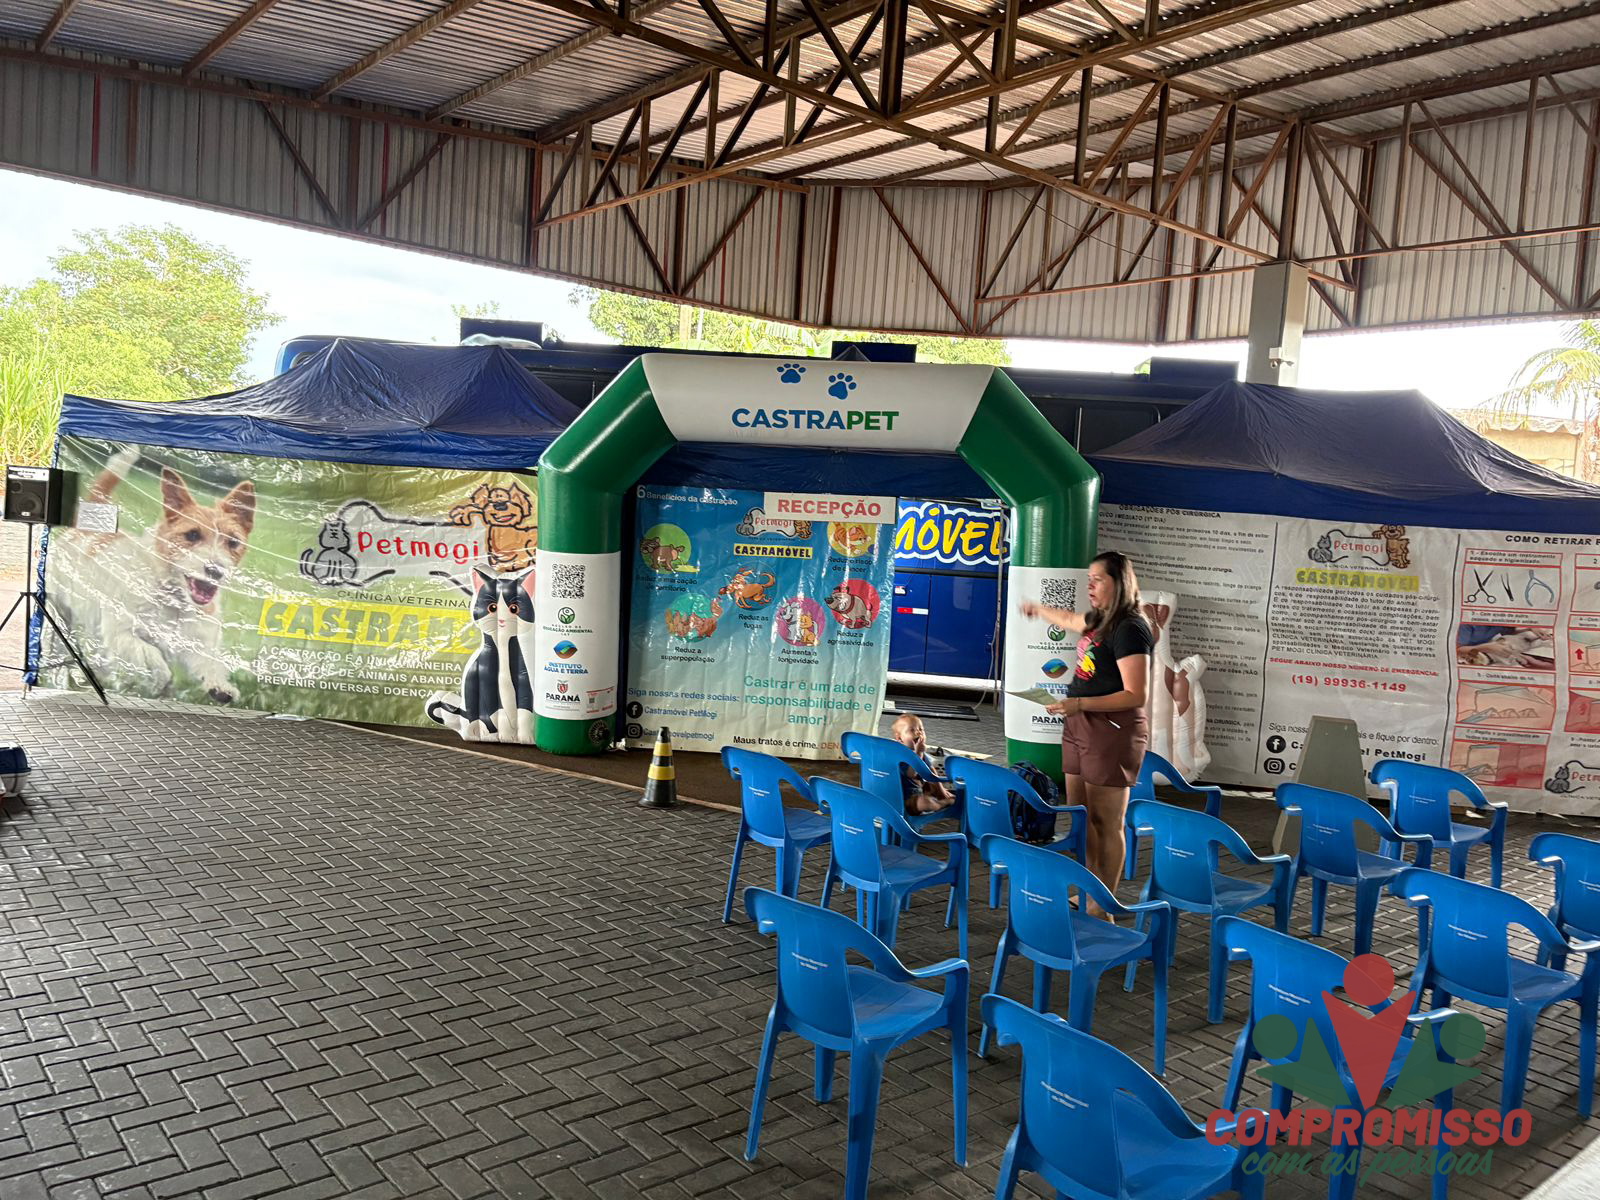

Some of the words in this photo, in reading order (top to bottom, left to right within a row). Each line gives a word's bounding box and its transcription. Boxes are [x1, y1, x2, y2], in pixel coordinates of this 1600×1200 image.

[732, 408, 899, 431] CASTRAPET
[778, 499, 882, 519] RECEPÇÃO
[358, 531, 479, 564] Petmogi
[1333, 540, 1384, 554] Petmogi
[1505, 535, 1540, 544] COMO
[1544, 537, 1592, 546] RETIRAR
[734, 545, 811, 558] CASTRAMÓVEL
[358, 670, 407, 682] ANIMAIS
[257, 675, 315, 688] PREVENIR
[320, 681, 379, 694] DIVERSAS
[744, 676, 796, 690] Castrar
[798, 679, 807, 690] é
[810, 681, 831, 692] um
[833, 682, 855, 694] ato
[858, 683, 876, 695] de
[1291, 674, 1319, 687] (19)
[1324, 676, 1407, 693] 99936-1149
[546, 692, 581, 702] PARANÁ
[628, 688, 647, 697] Siga
[680, 691, 705, 700] redes
[744, 694, 861, 711] responsabilidade
[864, 703, 872, 712] e
[787, 714, 828, 726] amor!
[1268, 722, 1287, 733] Siga
[733, 736, 756, 745] Maus
[758, 737, 783, 747] tratos
[784, 737, 791, 747] é
[792, 740, 818, 750] crime.
[1375, 732, 1396, 743] fique
[1397, 736, 1410, 745] por
[1375, 748, 1427, 762] PetMogi
